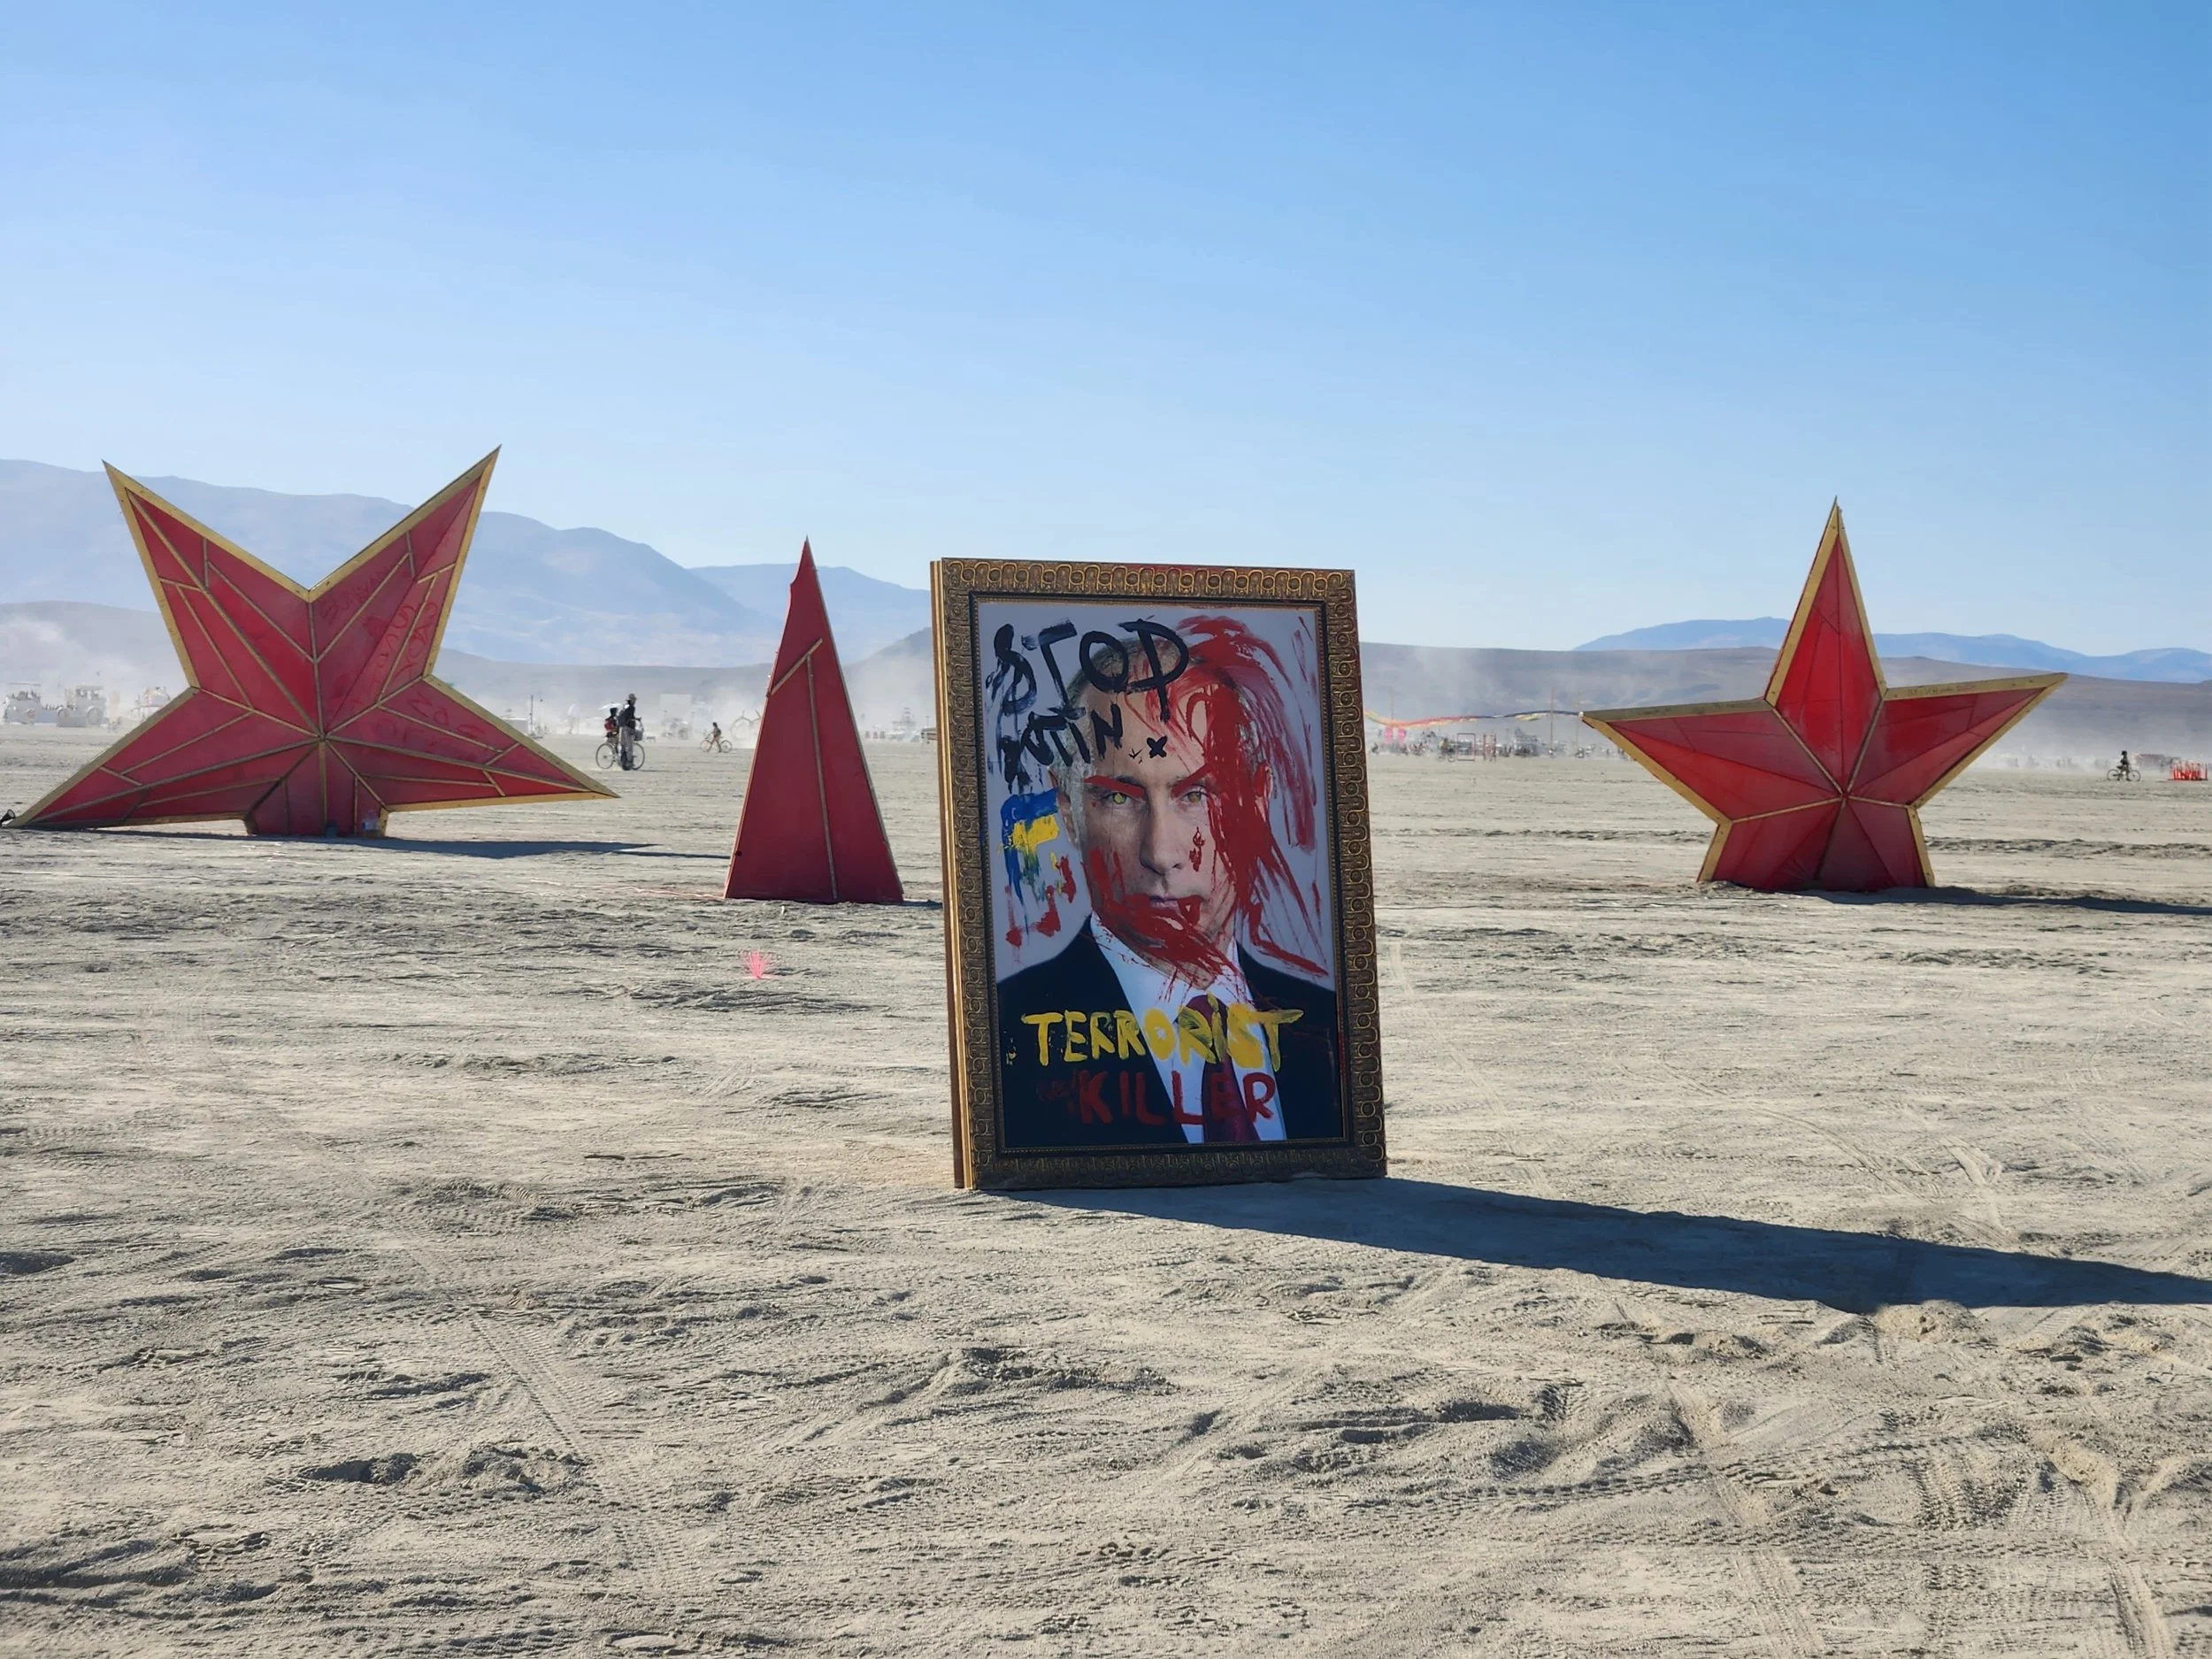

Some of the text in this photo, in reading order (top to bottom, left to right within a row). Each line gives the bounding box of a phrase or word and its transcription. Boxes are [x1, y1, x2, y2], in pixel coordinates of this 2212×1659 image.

[992, 617, 1189, 722] STOP
[1021, 995, 1304, 1072] TERRORIST
[1079, 1069, 1276, 1125] KILLER
